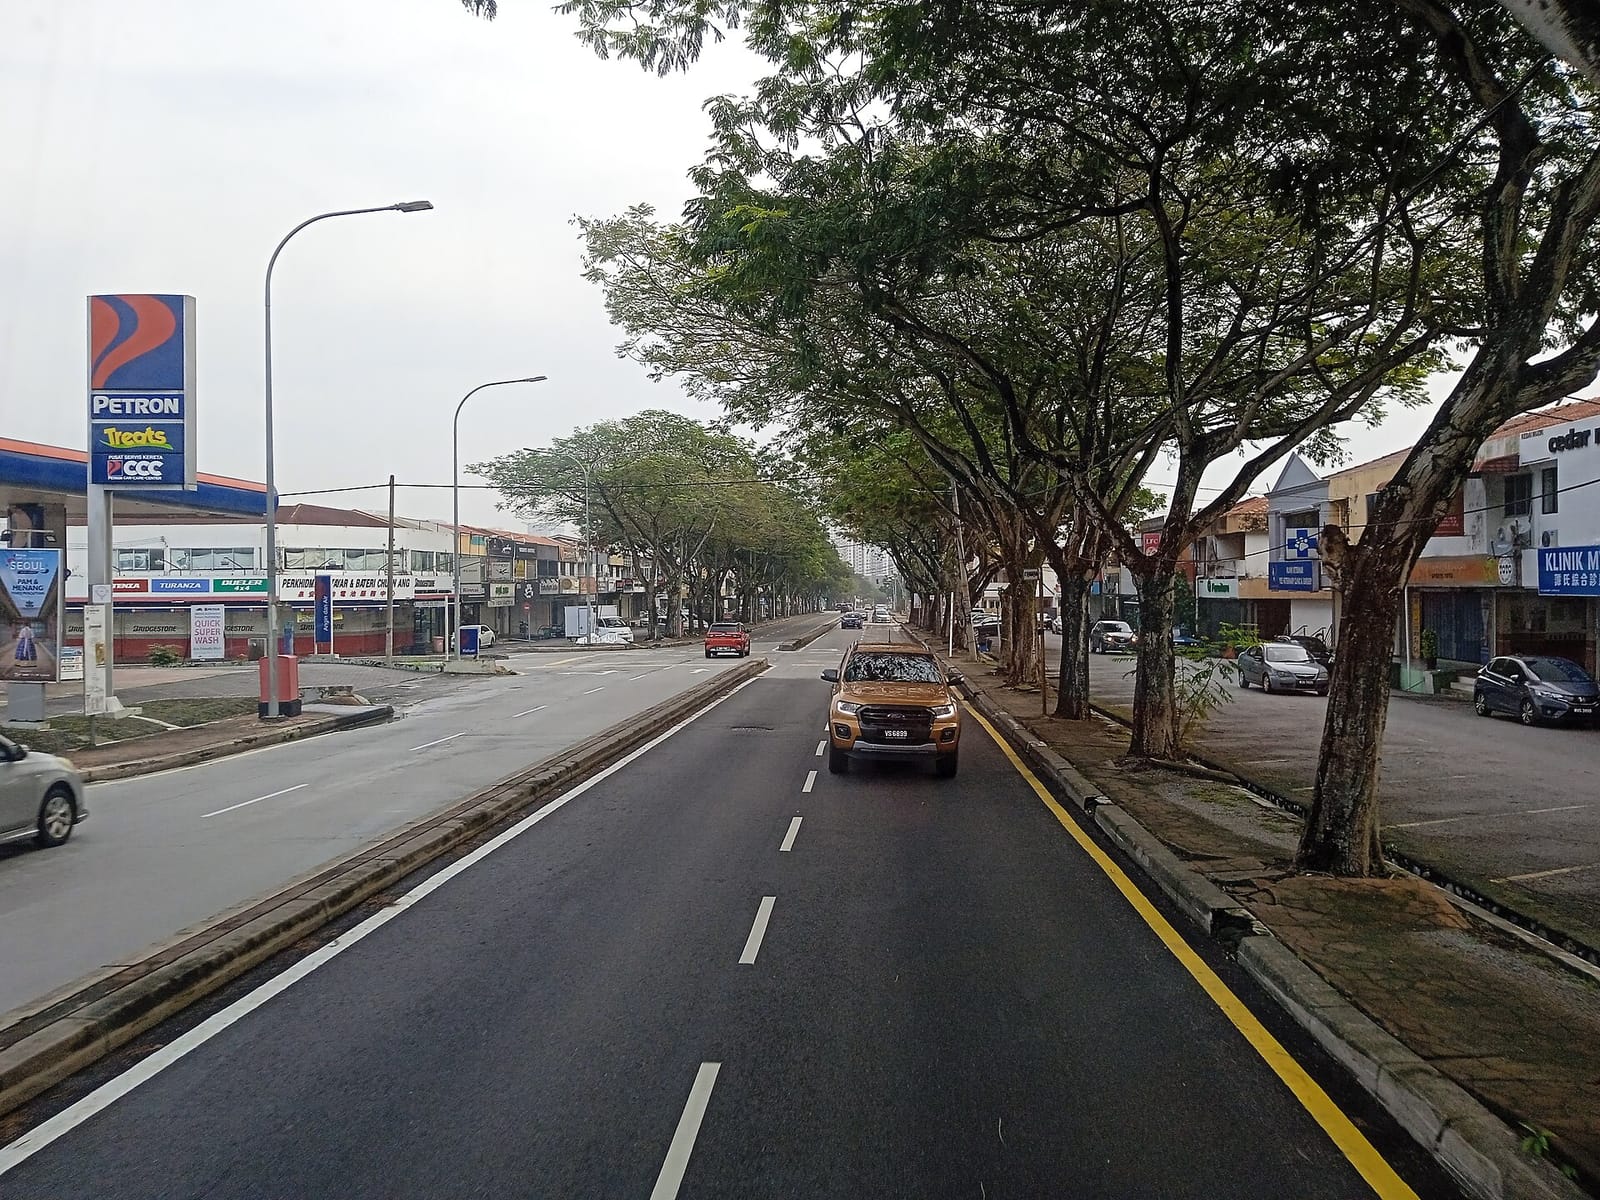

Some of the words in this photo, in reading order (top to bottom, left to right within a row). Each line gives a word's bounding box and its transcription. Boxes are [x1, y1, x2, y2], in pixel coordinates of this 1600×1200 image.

[93, 395, 179, 414] PETRON
[103, 426, 167, 446] Treats
[1548, 427, 1591, 453] cedar
[123, 460, 164, 476] CCC
[10, 561, 46, 570] SEOUL
[1545, 551, 1584, 572] KLINIK
[1587, 550, 1600, 571] M
[160, 582, 202, 590] TURANZA
[221, 579, 264, 587] DUELER
[281, 578, 316, 588] PERKHIDM
[355, 579, 376, 588] BATERI
[397, 579, 411, 588] ANG
[194, 619, 221, 628] QUICK
[132, 625, 177, 633] BRIDGESTONE
[194, 628, 221, 636] SUPER
[194, 637, 220, 645] WASH
